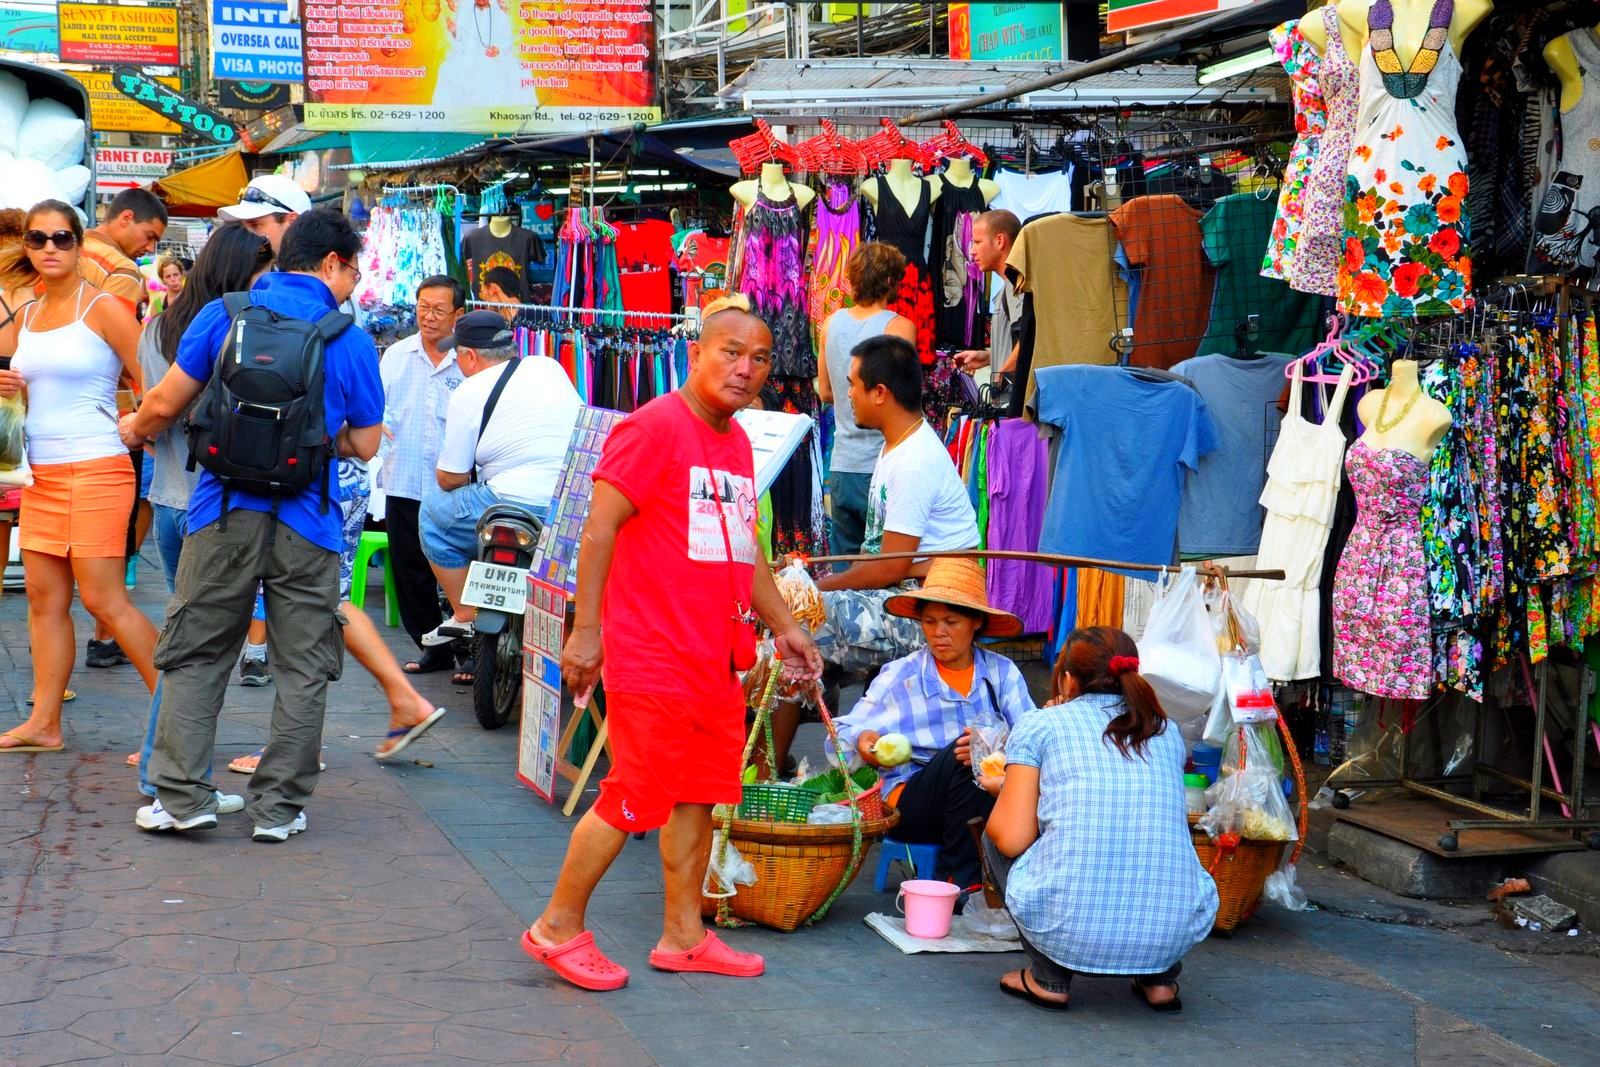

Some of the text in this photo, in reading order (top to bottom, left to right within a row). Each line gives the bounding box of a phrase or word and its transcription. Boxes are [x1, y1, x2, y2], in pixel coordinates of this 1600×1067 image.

[62, 8, 174, 24] SUNNY FASHIONS
[519, 10, 528, 18] to
[532, 10, 557, 19] those
[560, 10, 570, 19] of
[574, 10, 612, 22] opposite
[124, 34, 157, 42] ACCEPTED
[529, 28, 551, 36] good
[602, 28, 627, 37] when
[959, 13, 968, 50] 3
[978, 30, 999, 53] CHAN
[1038, 24, 1053, 38] AWAY
[221, 32, 299, 49] OVERSEA CALL
[565, 44, 593, 54] health
[596, 44, 613, 54] and
[616, 45, 649, 57] wealth,
[221, 57, 303, 75] VISA PHOTO
[520, 61, 642, 71] successful in business and
[521, 78, 567, 87] perfection
[120, 75, 233, 141] TATTOO
[370, 110, 445, 120] 02-629-1200
[490, 111, 531, 120] Khaosan
[560, 112, 575, 120] tel.
[579, 112, 654, 121] 02-629-1200
[521, 206, 531, 222] I
[695, 501, 733, 516] 201
[469, 581, 526, 596] กรุงเทพมหานคร
[483, 593, 506, 606] 39
